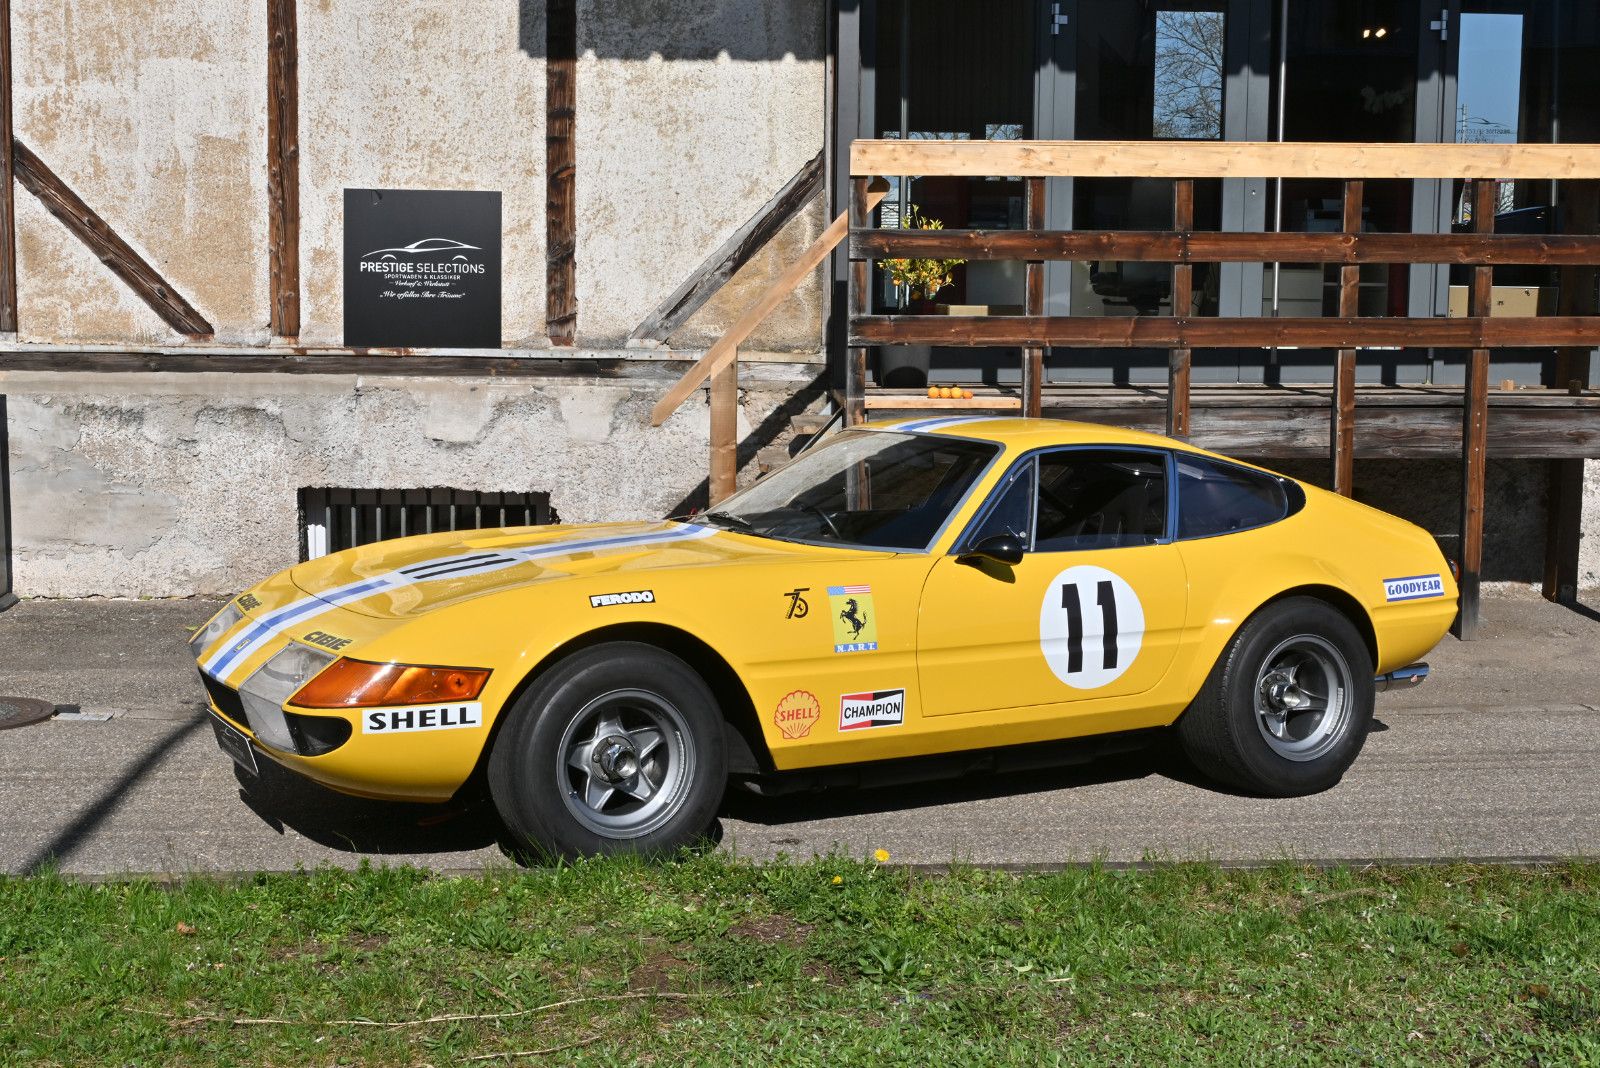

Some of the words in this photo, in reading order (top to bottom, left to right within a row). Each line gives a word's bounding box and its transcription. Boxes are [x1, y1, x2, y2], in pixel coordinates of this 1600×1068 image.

[360, 262, 414, 273] PRESTIGE
[416, 262, 485, 274] SELECTIONS
[1387, 579, 1441, 596] GOODYEAR
[590, 591, 654, 608] FERODO
[1062, 580, 1118, 673] 11
[368, 706, 477, 731] SHELL
[779, 707, 815, 722] SHELL
[843, 701, 901, 719] CHAMPION
